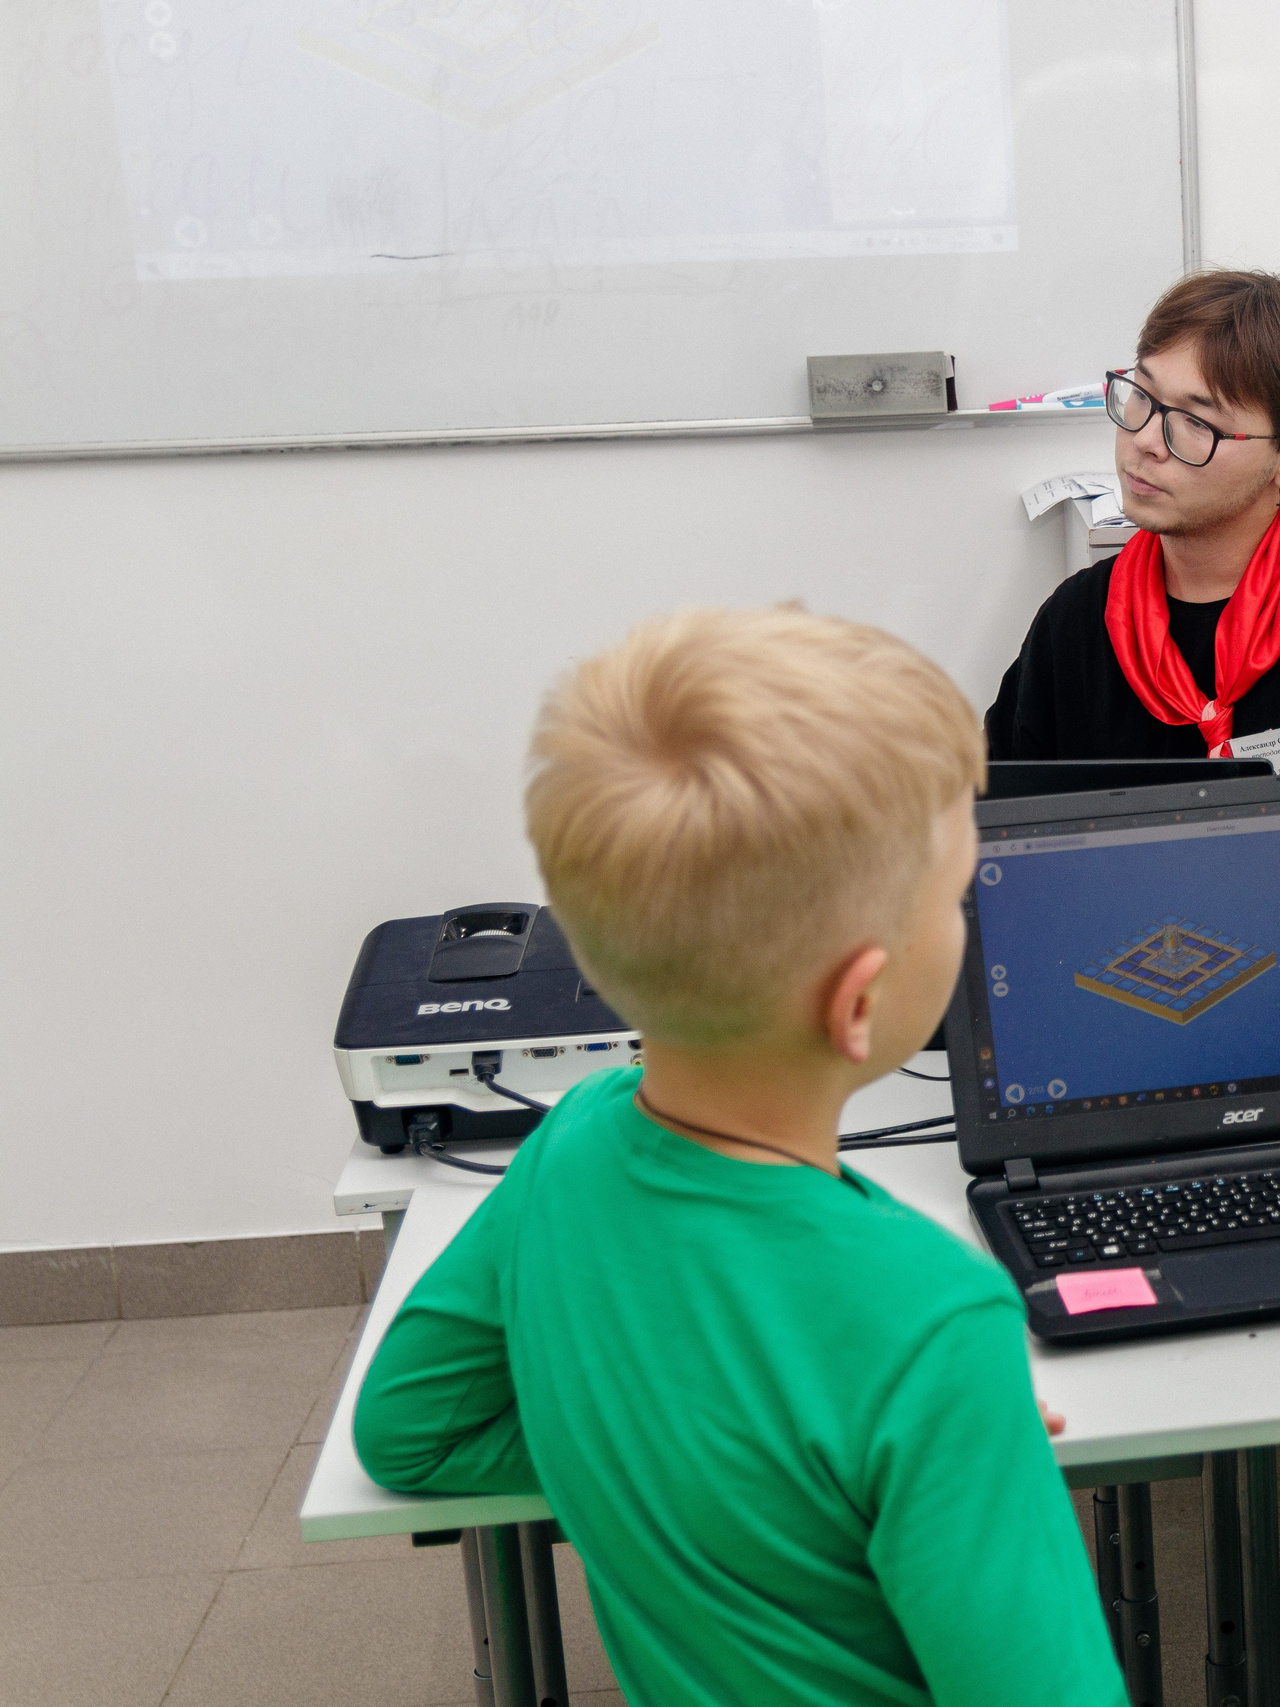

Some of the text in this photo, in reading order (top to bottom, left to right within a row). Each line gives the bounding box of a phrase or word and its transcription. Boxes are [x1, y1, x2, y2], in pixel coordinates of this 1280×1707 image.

[1240, 741, 1277, 753] Александр
[418, 998, 512, 1015] BenQ
[1222, 1108, 1264, 1125] acer
